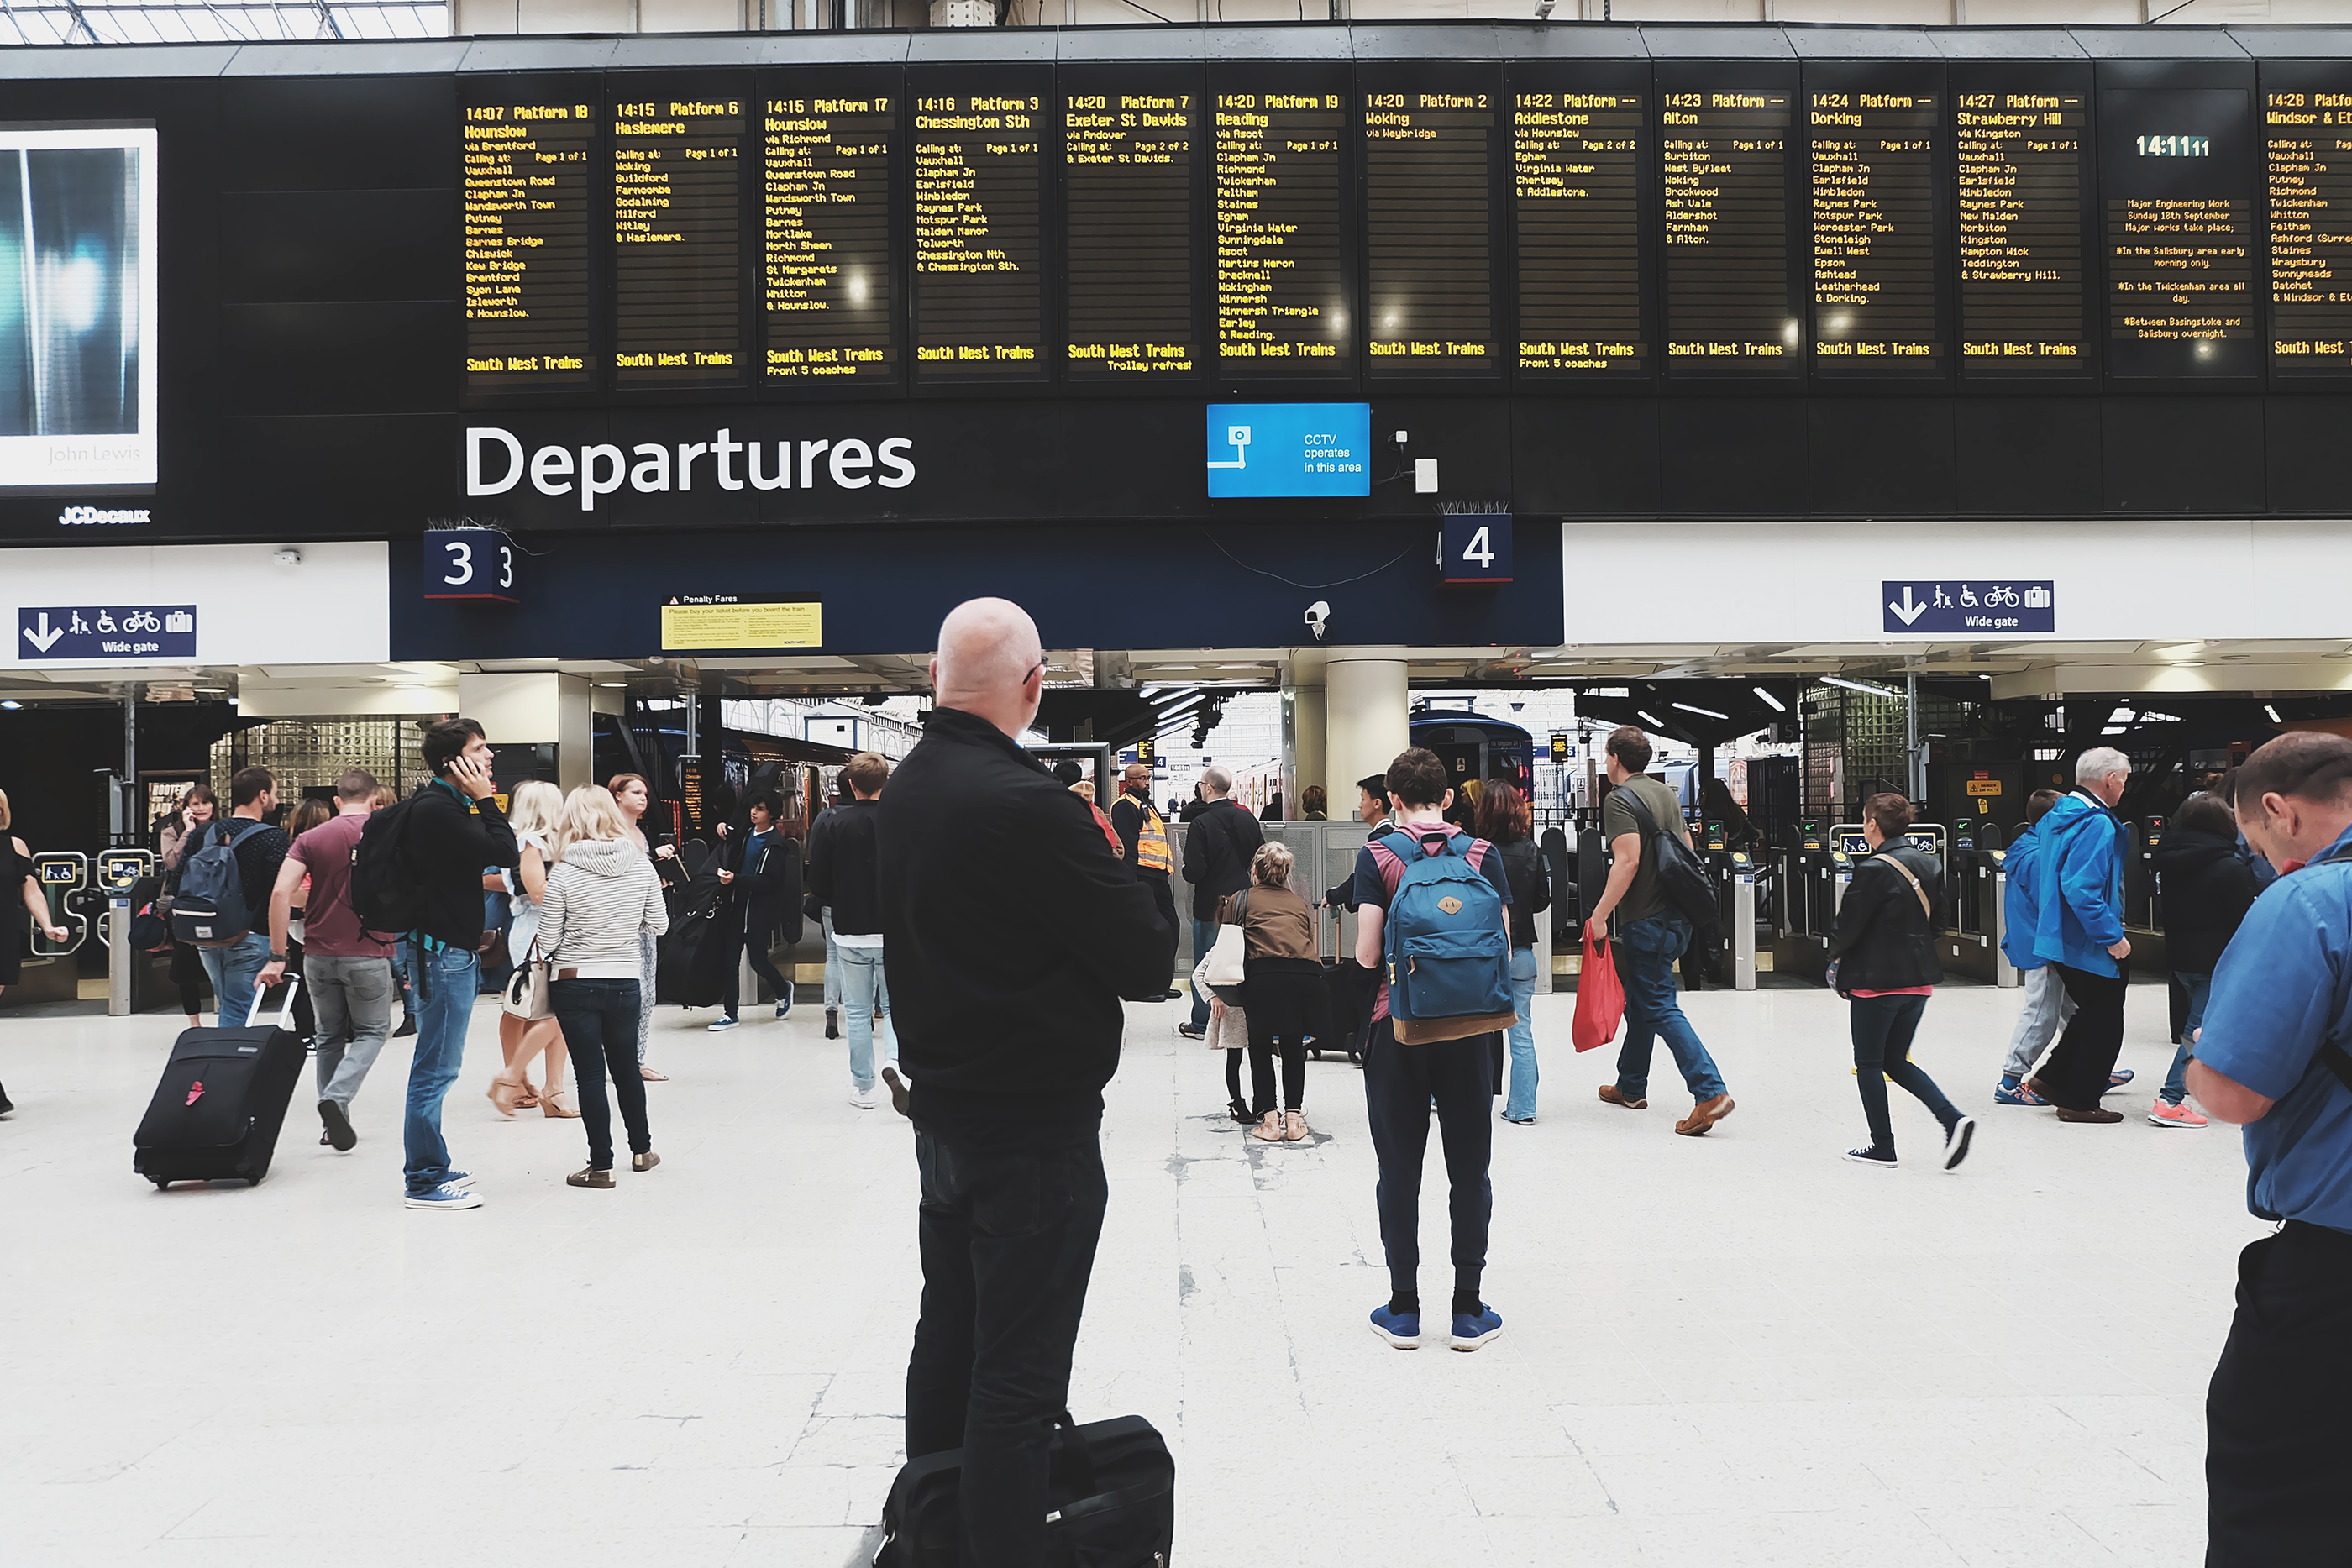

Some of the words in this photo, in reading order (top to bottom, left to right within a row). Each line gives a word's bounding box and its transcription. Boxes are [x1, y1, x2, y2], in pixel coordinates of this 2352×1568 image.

[767, 100, 804, 113] 14:15
[814, 99, 868, 113] Platform
[874, 98, 888, 112] 17
[918, 97, 955, 111] 14:16
[971, 97, 1024, 111] Platform
[1030, 97, 1038, 110] 3
[1068, 96, 1105, 109] 14:20
[1121, 96, 1174, 109] Platform
[1180, 96, 1189, 108] 7
[1218, 95, 1255, 108] 14:20
[1265, 95, 1318, 108] Platform
[1326, 95, 1338, 108] 19
[1368, 94, 1404, 107] 14:20
[1420, 94, 1473, 108] Platform
[1478, 95, 1487, 108] 2
[1516, 94, 1552, 108] 14:22
[1564, 94, 1616, 108] Platform
[1665, 94, 1701, 107] 14:23
[1713, 94, 1765, 108] Platform
[1813, 94, 1848, 107] 14:24
[1860, 94, 1912, 108] Platform
[1959, 95, 1995, 108] 14:27
[2007, 95, 2059, 108] Platform
[2268, 93, 2304, 107] 14:28
[467, 107, 504, 120] 14:07
[514, 106, 568, 120] Platform
[575, 105, 588, 118] 18
[617, 103, 654, 117] 14:15
[670, 102, 724, 116] Platform
[729, 102, 738, 114] 6
[916, 115, 1000, 130] Chessington
[1005, 115, 1030, 128] Sth
[1067, 113, 1114, 127] Exeter
[1121, 113, 1137, 127] St
[1143, 113, 1187, 126] Davids
[1216, 113, 1268, 127] Reading
[1366, 112, 1409, 127] Woking
[1515, 112, 1588, 125] Addlestone
[1664, 112, 1698, 124] Alton
[1811, 112, 1861, 127] Dorking
[1958, 113, 2037, 127] Strawberry
[2044, 113, 2061, 125] Hill
[2267, 112, 2318, 123] Windsor
[616, 121, 685, 134] Haslemere
[765, 118, 827, 131] Hounslow
[465, 124, 527, 139] Hounslow
[1067, 131, 1080, 139] via
[1084, 130, 1126, 139] Andover
[1383, 128, 1436, 139] Weybridge
[765, 135, 780, 144] via
[782, 134, 831, 144] Richmond
[465, 143, 479, 151] via
[482, 141, 536, 151] Brentford
[1067, 142, 1095, 153] Calling
[1136, 142, 1156, 152] Page
[1159, 142, 1165, 150] 2
[1168, 142, 1179, 150] of
[1183, 142, 1189, 150] 2
[1812, 152, 1857, 161] Vauxhall
[465, 165, 512, 176] Vauxhall
[1516, 164, 1561, 175] Virginia
[1566, 164, 1595, 173] Water
[1665, 164, 1688, 172] West
[1693, 164, 1731, 175] Byfleet
[465, 178, 526, 187] Queenstown
[530, 176, 555, 186] Road
[616, 173, 668, 183] Guildford
[916, 180, 974, 189] Earlsfield
[1217, 188, 1258, 197] Feltham
[916, 203, 953, 214] Raynes
[958, 203, 982, 212] Park
[1218, 200, 1258, 209] Staines
[1666, 199, 1683, 207] Ash
[1688, 199, 1711, 207] Vale
[2128, 200, 2152, 209] Major
[2156, 200, 2205, 209] Engineering
[1961, 212, 1978, 220] New
[1982, 212, 2018, 220] Malden
[2128, 211, 2158, 222] Sunday
[2184, 212, 2230, 221] September
[2125, 223, 2150, 233] Major
[1814, 246, 1842, 255] Ewell
[1847, 247, 1870, 255] West
[2154, 247, 2193, 257] Salisbury
[2221, 247, 2244, 256] early
[2154, 260, 2187, 269] morning
[2273, 281, 2313, 290] Datchet
[767, 289, 806, 298] Whitton
[1219, 307, 1267, 315] Winnersh
[1272, 306, 1319, 317] Triangle
[2170, 317, 2221, 328] Basingstoke
[2225, 317, 2240, 326] and
[2139, 329, 2178, 339] Salisbury
[1964, 343, 1998, 355] South
[2004, 343, 2033, 355] West
[2039, 343, 2076, 355] Trains
[2275, 341, 2310, 354] South
[2315, 341, 2344, 354] West
[467, 358, 503, 371] South
[508, 357, 538, 370] West
[543, 356, 583, 370] Trains
[1107, 360, 1148, 372] Trolley
[767, 366, 797, 375] Front
[801, 365, 808, 375] 5
[812, 365, 856, 375] coaches
[1304, 434, 1336, 445] CCTV
[49, 445, 87, 466] John
[93, 444, 140, 460] Lewis
[1304, 448, 1351, 459] operates
[466, 427, 916, 511] Departures
[1305, 462, 1314, 473] in
[1316, 462, 1336, 473] this
[1338, 464, 1362, 473] area
[59, 506, 151, 525] JCDecaux
[1462, 527, 1495, 568] 4
[444, 542, 473, 585] 3
[499, 546, 512, 588] 3
[683, 595, 712, 604] Penalty
[715, 595, 738, 603] Fares
[1965, 616, 1992, 627] Wide
[1994, 617, 2018, 628] gate
[102, 641, 131, 653] Wide
[133, 642, 159, 654] gate
[1784, 724, 1794, 738] 5
[1157, 758, 1163, 766] 4
